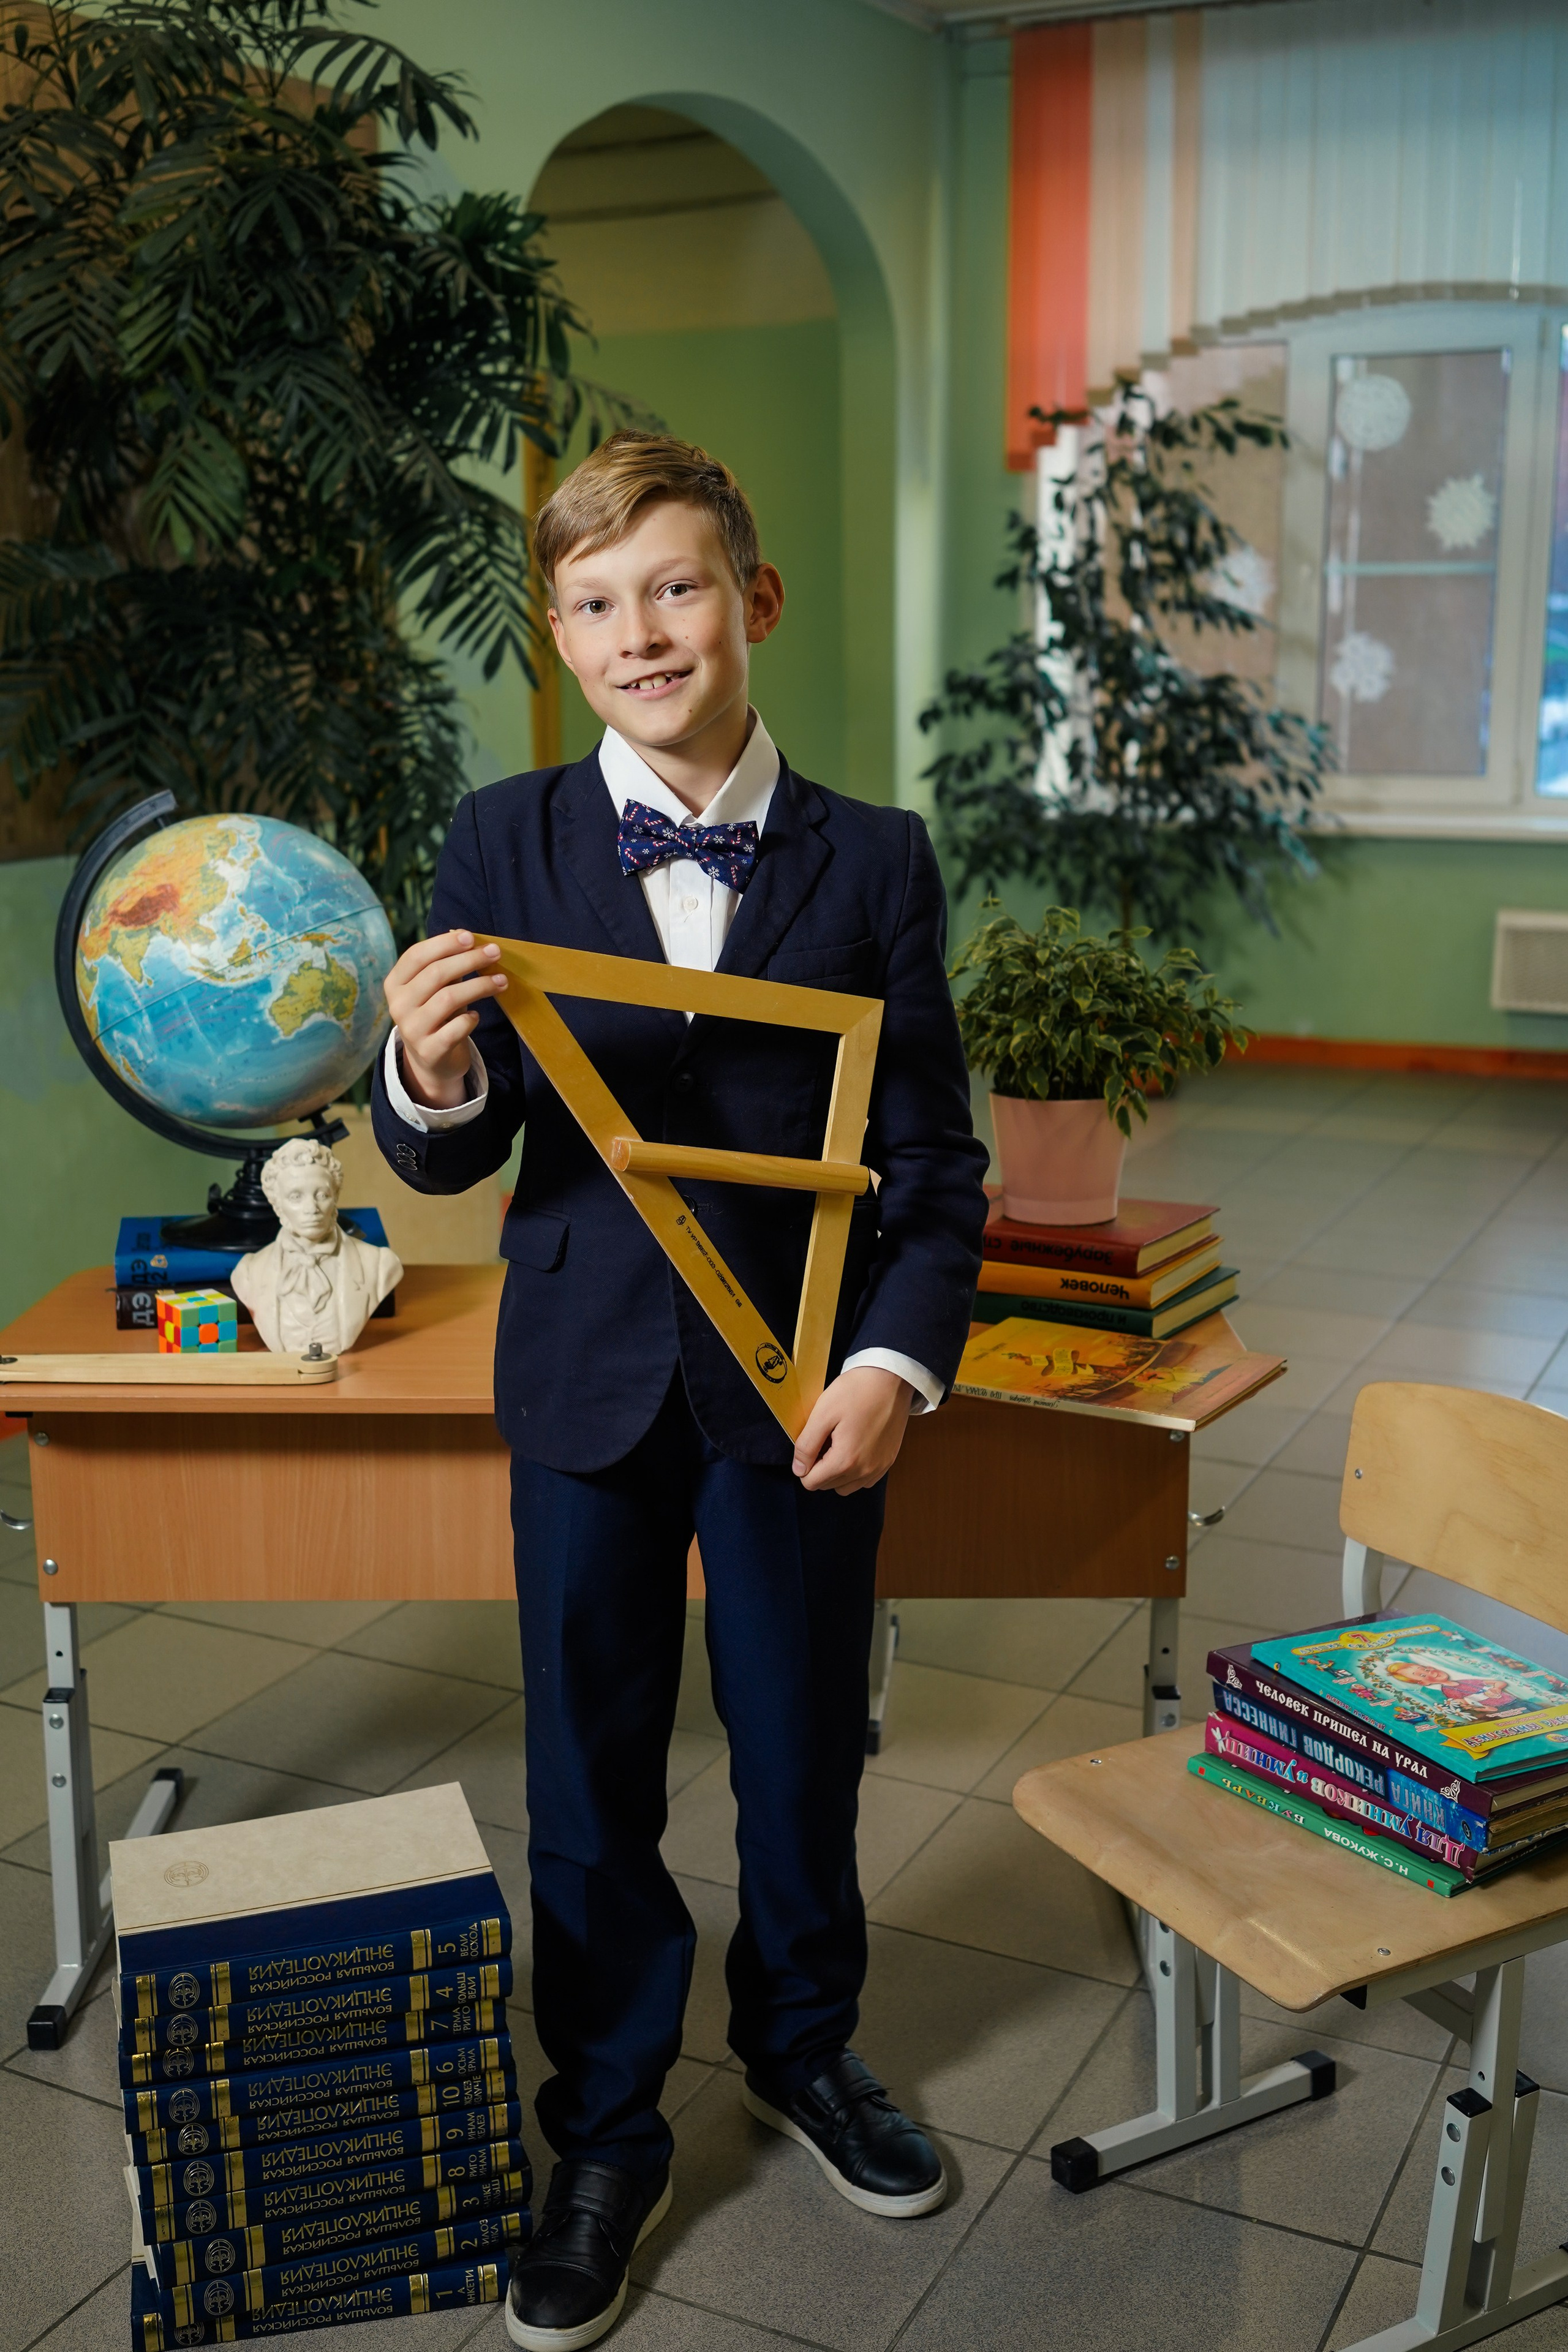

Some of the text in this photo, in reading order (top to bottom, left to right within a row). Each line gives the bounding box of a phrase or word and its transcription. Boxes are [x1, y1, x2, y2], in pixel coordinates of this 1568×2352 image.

[1011, 1240, 1114, 1265] Зарубежные
[1060, 1278, 1130, 1300] Человек
[132, 1292, 154, 1327] ДЭ
[1020, 1300, 1128, 1325] и производство
[1349, 1632, 1371, 1643] 7
[1256, 1679, 1428, 1779] ЧЕЛОВЕК ПРИШЕЛ НА УРАЛ
[1461, 1722, 1544, 1748] ДЕНИСКИНЫ
[1223, 1689, 1446, 1829] КНИГА РЕКОРДОВ ГИННЕССА
[1295, 1769, 1310, 1784] и
[1222, 1777, 1306, 1825] БУКВАРЬ
[438, 1943, 456, 1954] 5
[459, 1934, 469, 1957] ВЕЛИ
[248, 1944, 394, 1981] ЭНЦИКЛОПЕДИЯ
[249, 1961, 394, 1993] БОЛЬШАЯ РОССИЙСКАЯ
[436, 1986, 453, 1998] 4
[457, 1972, 466, 2004] БОЛЬШ
[467, 1977, 477, 1999] ВЕЛИ
[247, 1988, 391, 2021] ЭНЦИКЛОПЕДИЯ
[248, 2004, 392, 2034] БОЛЬШАЯ РОССИЙСКАЯ
[243, 2020, 386, 2053] ЭНЦИКЛОПЕДИЯ
[431, 2020, 448, 2030] 7
[243, 2037, 387, 2065] БОЛЬШАЯ РОССИЙСКАЯ
[468, 2048, 477, 2073] ЕРМА
[248, 2063, 392, 2097] ЭНЦИКЛОПЕДИЯ
[436, 2062, 454, 2073] 6
[249, 2080, 393, 2109] БОЛЬШАЯ РОССИЙСКАЯ
[442, 2086, 460, 2106] 10
[257, 2094, 400, 2131] ЭНЦИКЛОПЕДИЯ
[257, 2109, 400, 2141] БОЛЬШАЯ РОССИЙСКАЯ
[467, 2112, 476, 2141] ИНАМ
[446, 2128, 464, 2139] 9
[261, 2130, 403, 2167] ЭНЦИКЛОПЕДИЯ
[263, 2147, 404, 2179] БОЛЬШАЯ РОССИЙСКАЯ
[478, 2149, 488, 2176] ИНАМ
[448, 2166, 466, 2177] 8
[469, 2154, 478, 2177] РИГО
[264, 2169, 404, 2206] ЭНЦИКЛОПЕДИЯ
[265, 2185, 405, 2217] БОЛЬШАЯ РОССИЙСКАЯ
[462, 2197, 480, 2207] 3
[281, 2201, 420, 2243] ЭНЦИКЛОПЕДИЯ
[283, 2217, 421, 2256] БОЛЬШАЯ РОССИЙСКАЯ
[461, 2238, 478, 2250] 2
[280, 2243, 418, 2285] ЭНЦИКЛОПЕДИЯ
[281, 2260, 420, 2298] БОЛЬШАЯ РОССИЙСКАЯ
[465, 2269, 475, 2304] АНКЕТИ
[435, 2290, 453, 2299] 1
[253, 2305, 393, 2334] БОЛЬШАЯ РОССИЙСКАЯ
